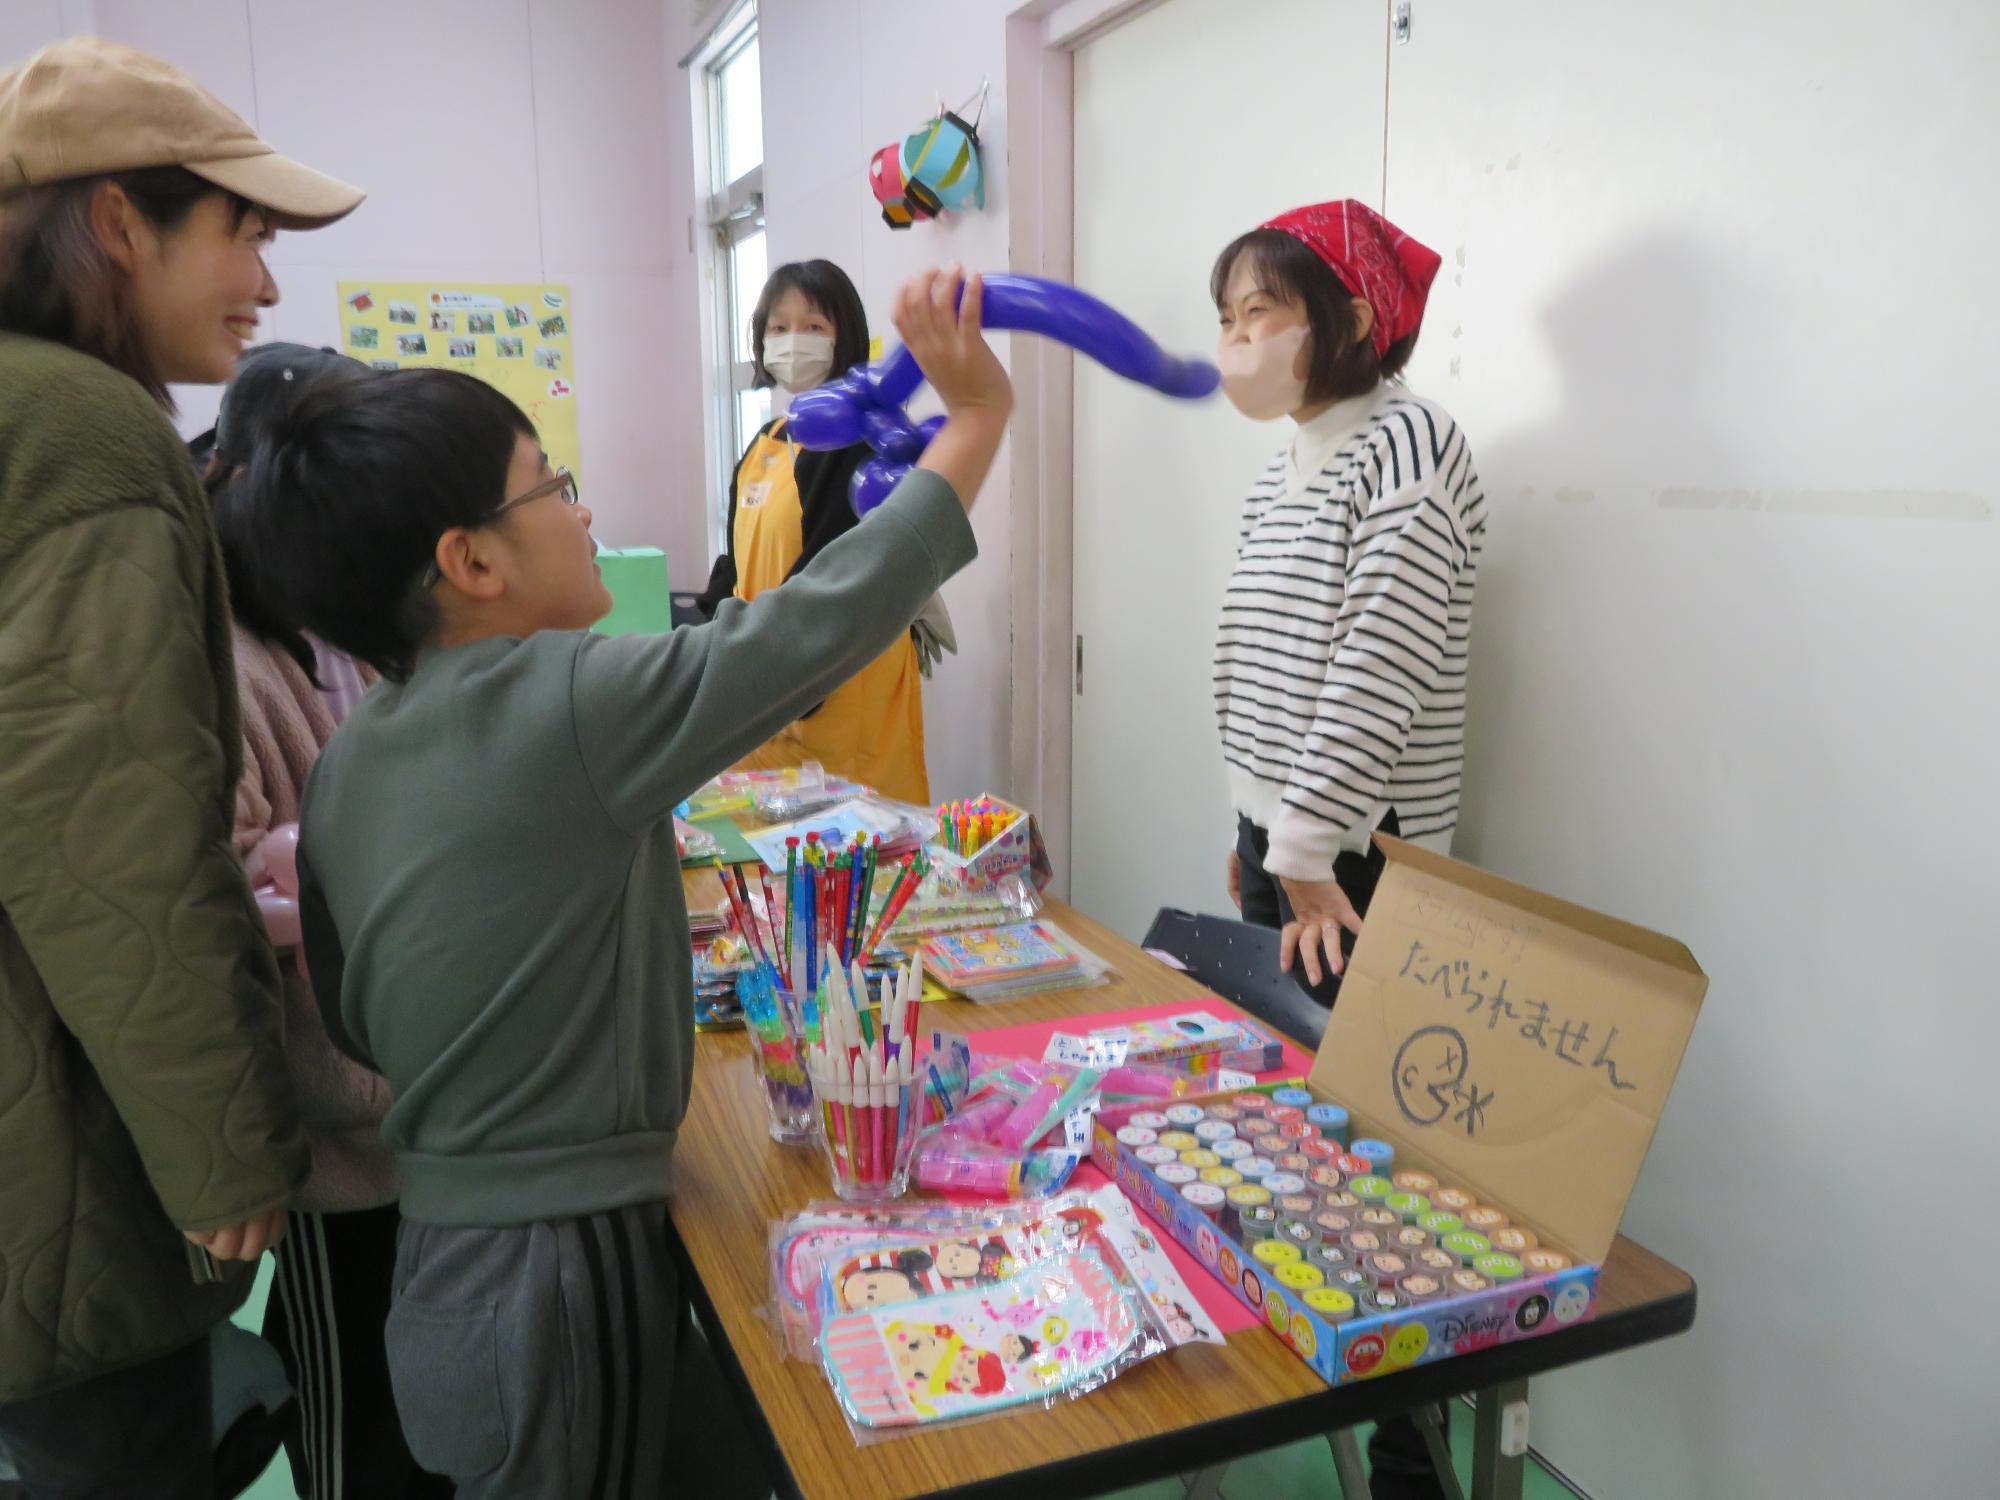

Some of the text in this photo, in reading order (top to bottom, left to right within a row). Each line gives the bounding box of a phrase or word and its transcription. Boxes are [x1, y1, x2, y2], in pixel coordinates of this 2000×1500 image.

[1399, 940, 1637, 1090] たべられません
